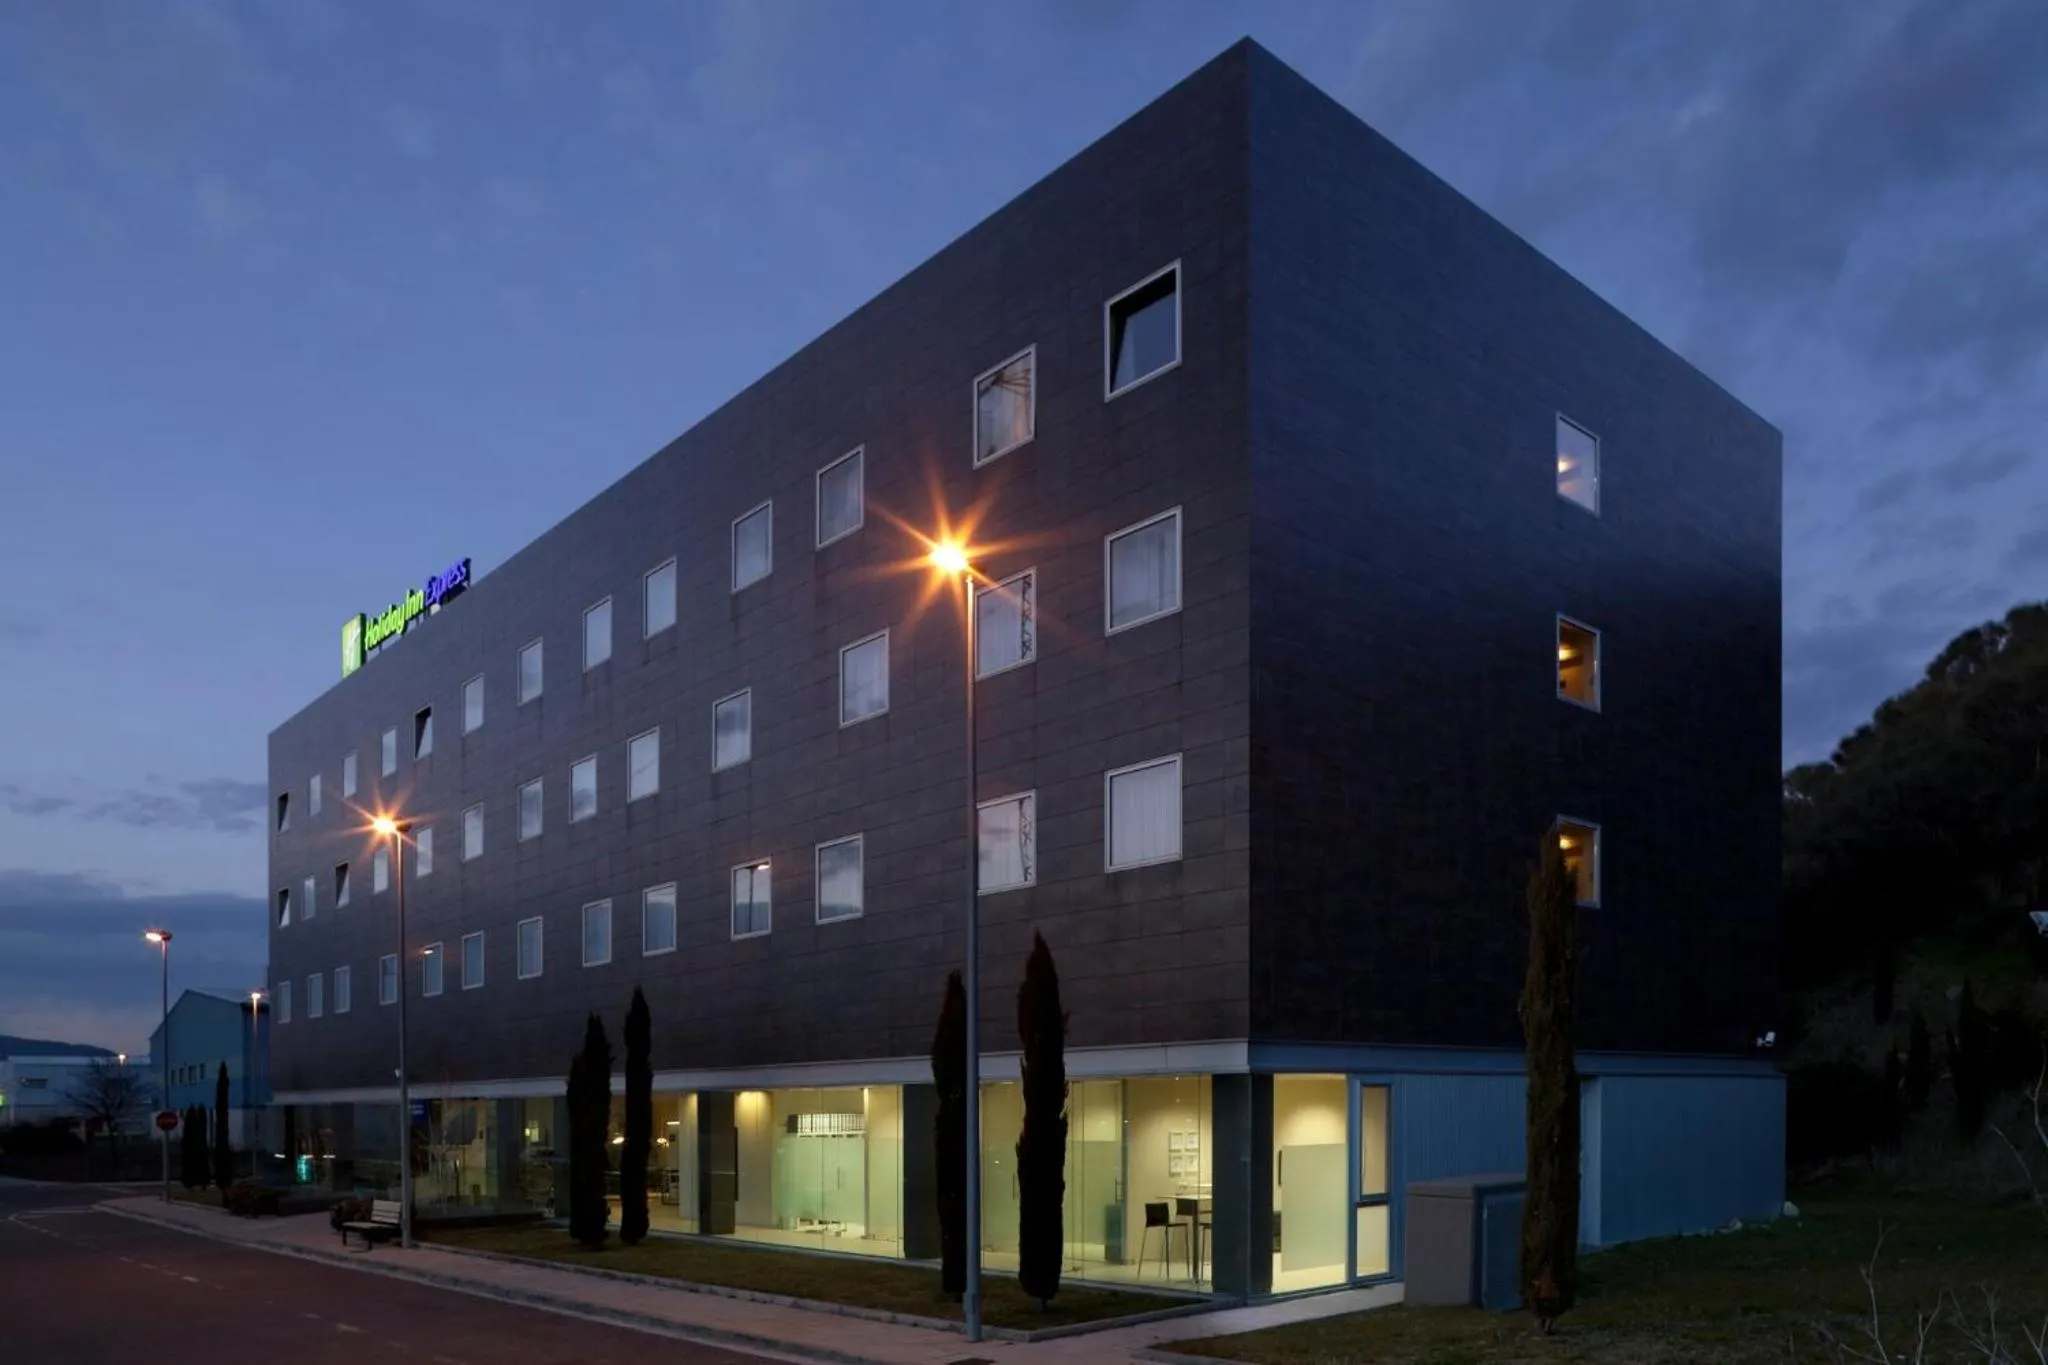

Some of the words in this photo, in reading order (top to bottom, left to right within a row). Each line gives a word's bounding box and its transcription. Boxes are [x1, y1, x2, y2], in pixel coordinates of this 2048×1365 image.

[365, 602, 405, 650] Holiday
[405, 588, 424, 620] Inn
[425, 559, 468, 606] Express
